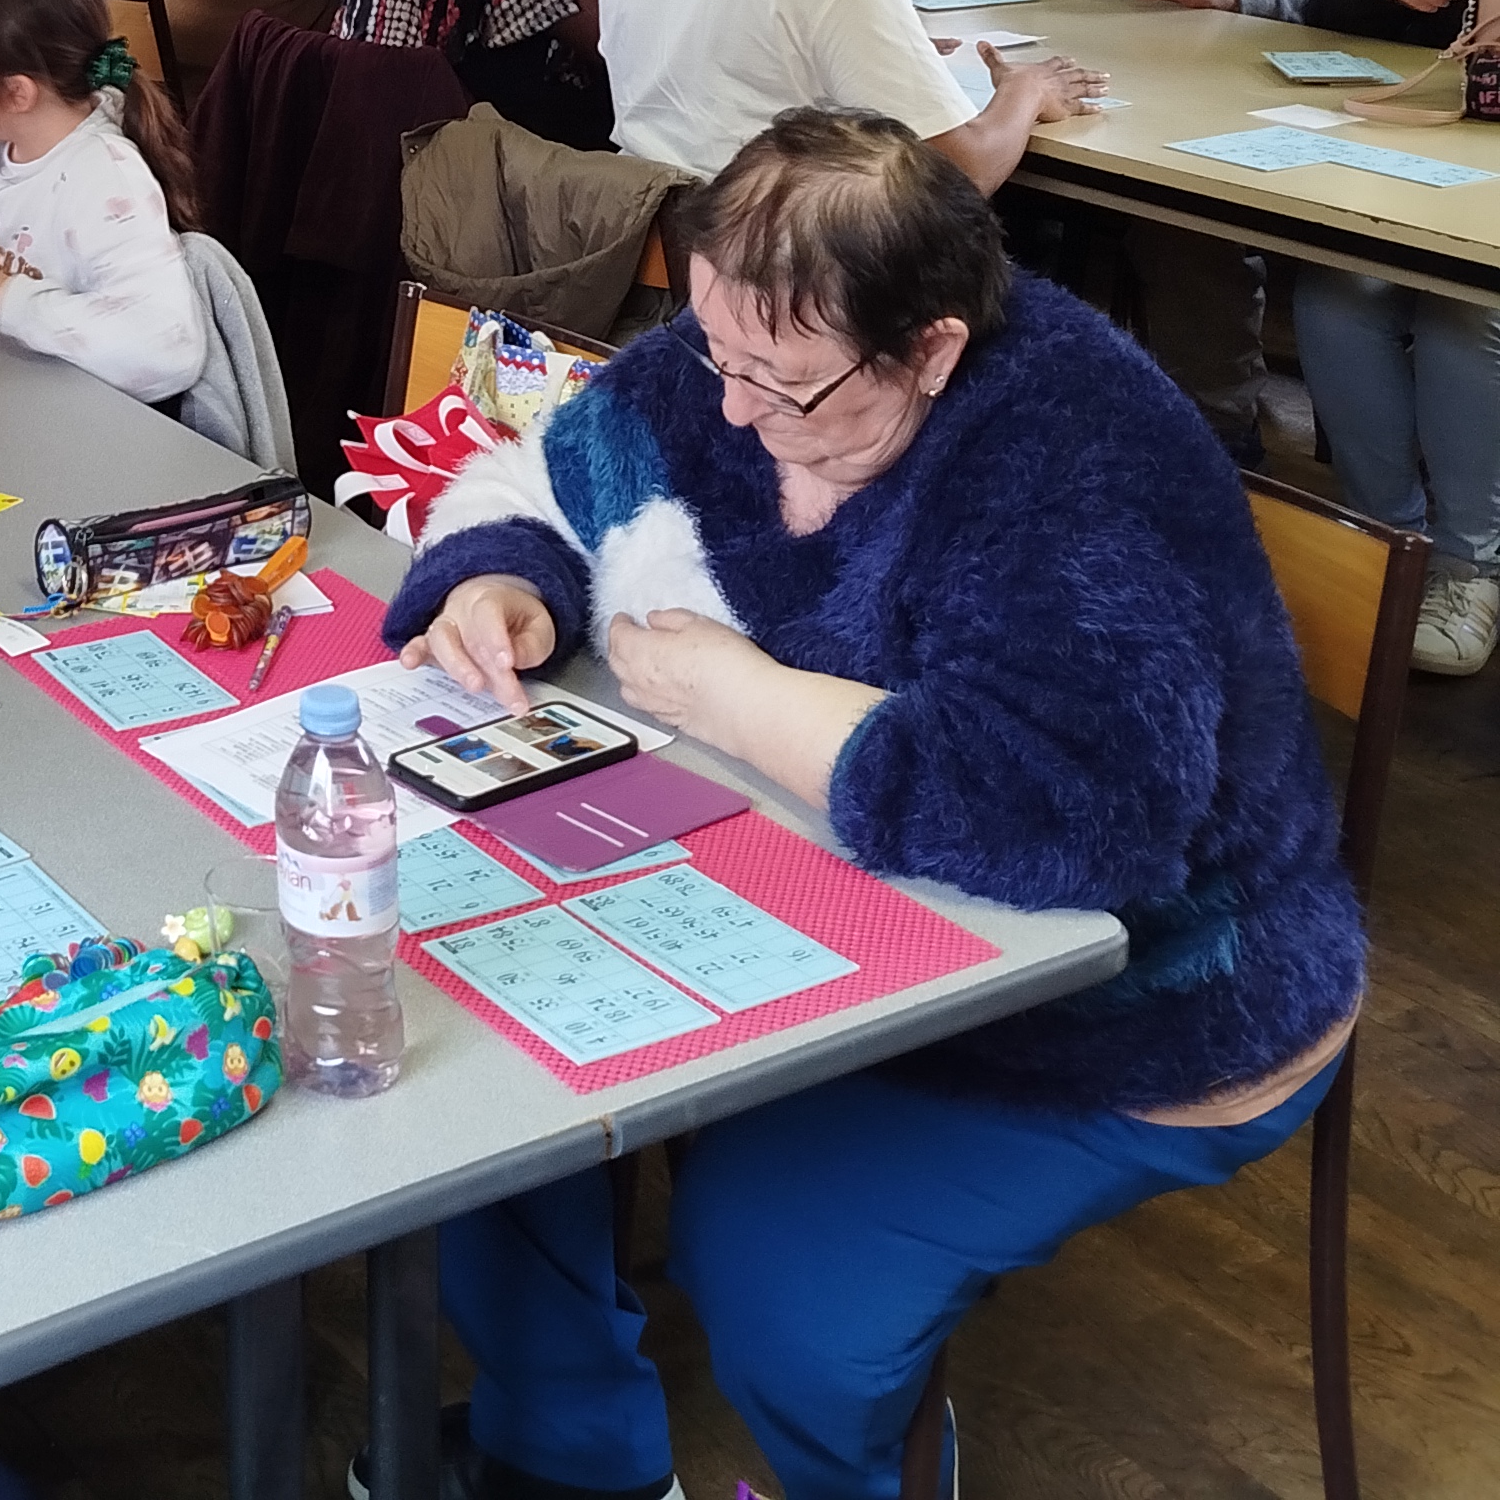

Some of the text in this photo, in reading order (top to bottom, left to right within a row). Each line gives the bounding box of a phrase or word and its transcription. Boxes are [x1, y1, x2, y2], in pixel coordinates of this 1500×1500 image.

[61, 656, 81, 667] 72
[88, 679, 109, 688] 41
[173, 682, 197, 691] 29
[183, 688, 206, 698] 14
[128, 712, 148, 720] 2
[413, 832, 490, 882] 24 45 57 6
[279, 866, 312, 892] vian
[426, 878, 480, 910] 6 21
[28, 902, 55, 916] 31
[51, 924, 78, 938] 51
[622, 916, 650, 928] 61
[657, 873, 813, 962] 16 47 59 78 89
[638, 896, 760, 964] 27 45 56 65 77
[640, 927, 668, 940] 51
[11, 935, 38, 949] 54
[445, 936, 476, 951] 81
[657, 939, 684, 950] 40
[521, 916, 671, 1011] 19 27 59 69 87
[695, 961, 724, 975] 22
[486, 925, 633, 1023] 18 24 46 75 84
[496, 972, 525, 985] 50
[563, 1021, 594, 1035] 10
[585, 1035, 607, 1044] 4
